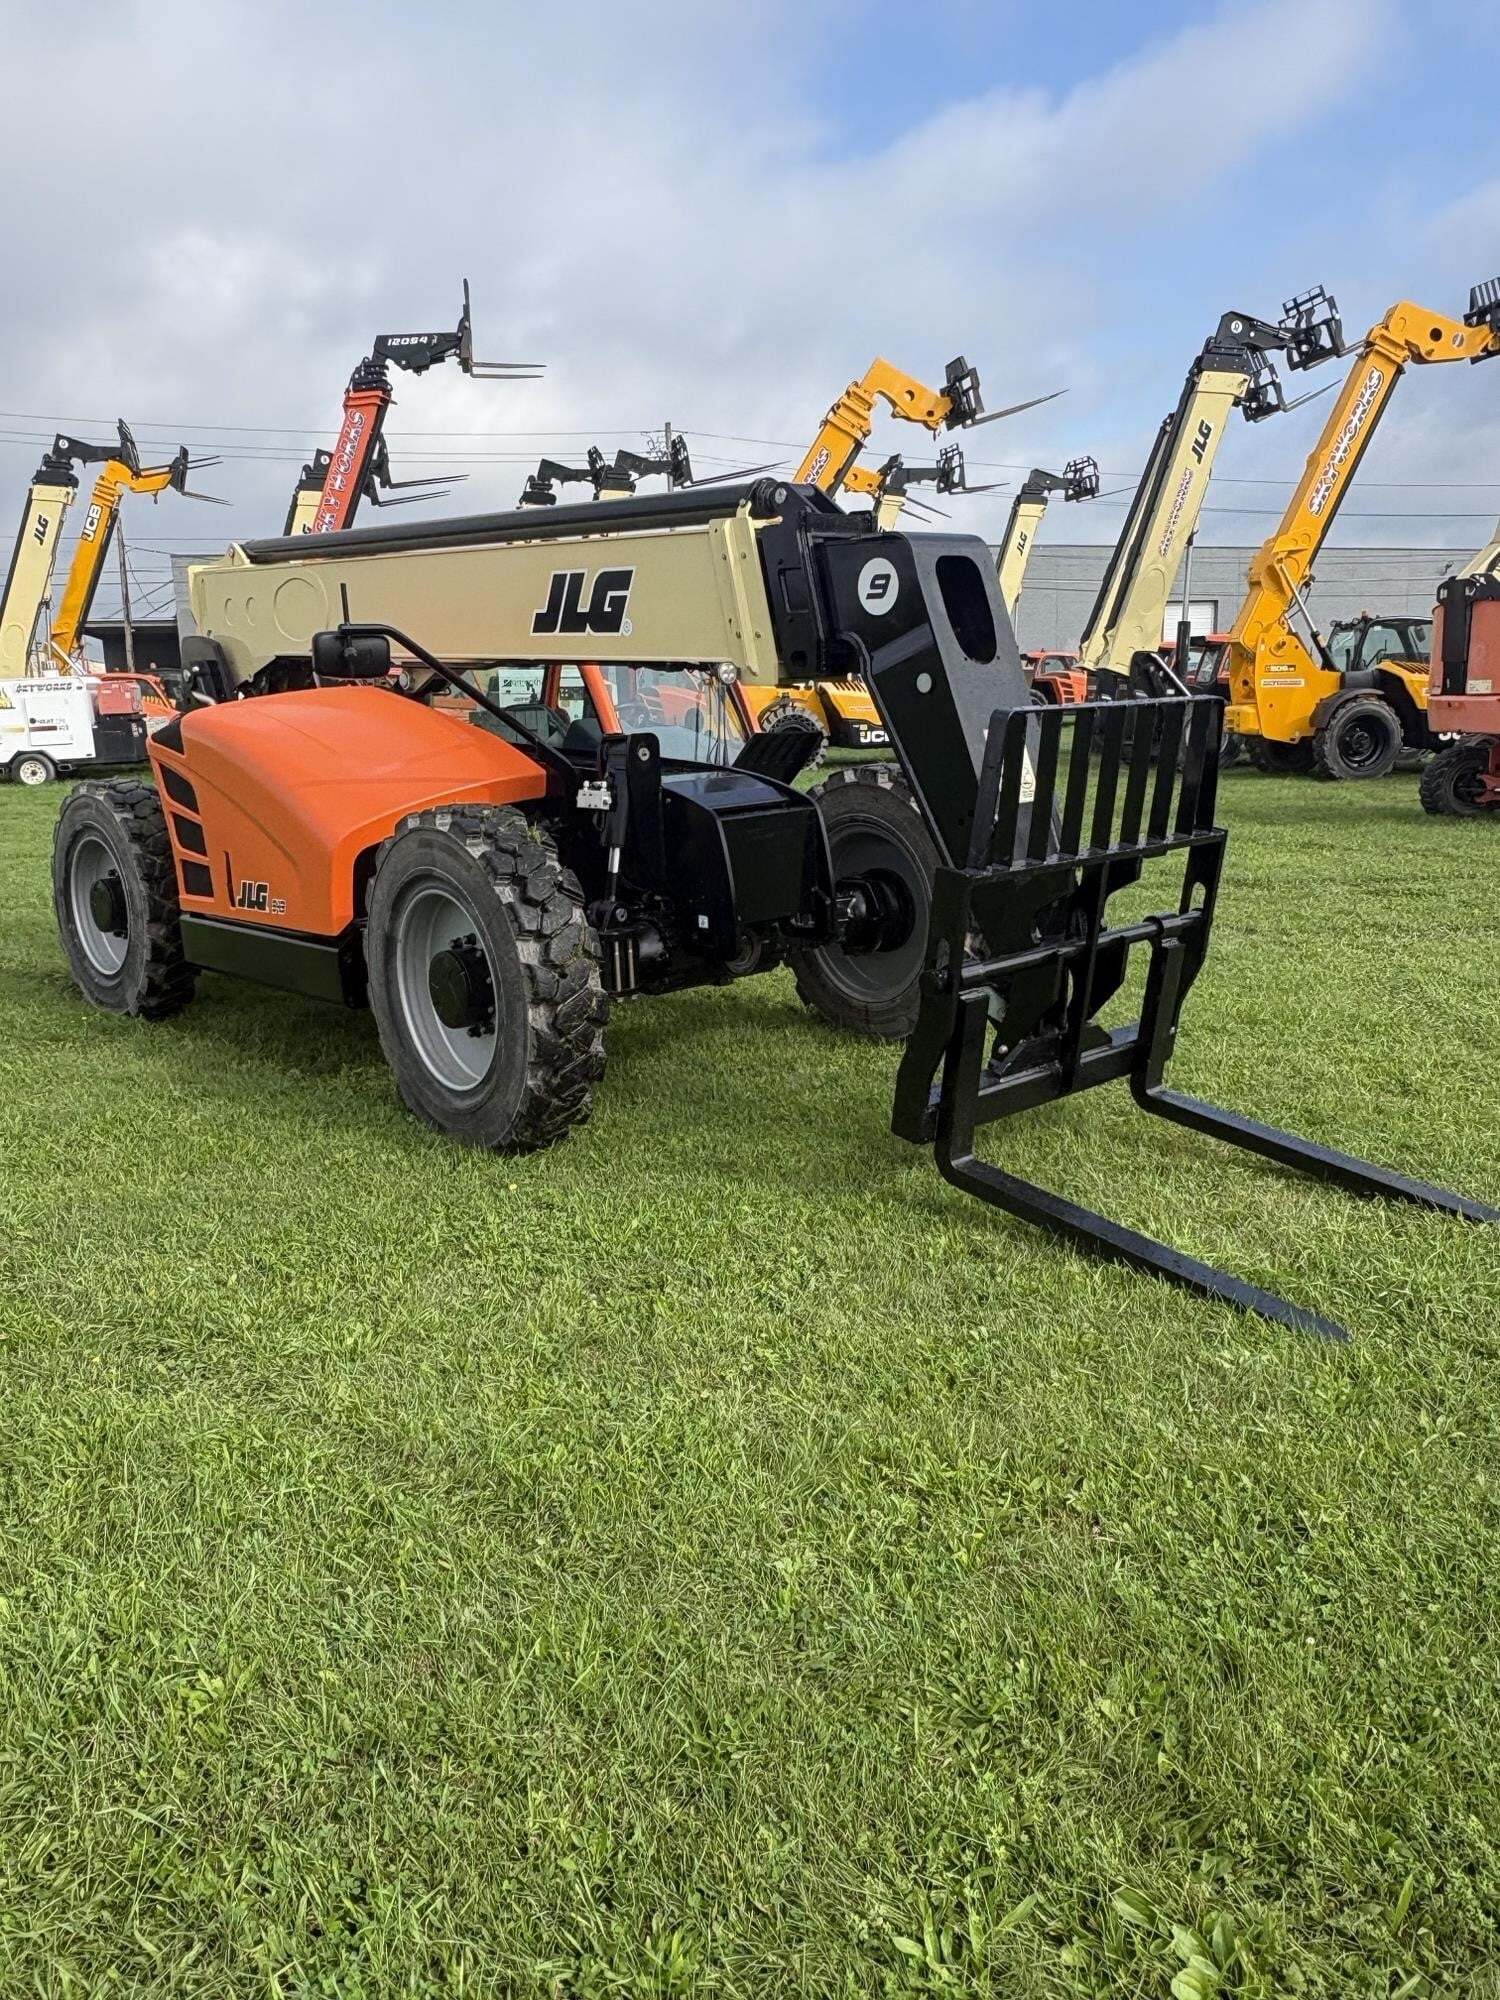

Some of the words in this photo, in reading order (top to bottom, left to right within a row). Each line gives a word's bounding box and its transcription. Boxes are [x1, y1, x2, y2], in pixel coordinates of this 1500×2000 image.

[1191, 418, 1213, 465] JLG
[1308, 366, 1384, 517] SKYWORKS
[33, 513, 49, 546] JLG
[81, 503, 102, 542] JCB
[1016, 531, 1027, 557] JLG
[530, 567, 636, 636] JLG
[865, 573, 891, 600] 9
[236, 880, 269, 913] JLG
